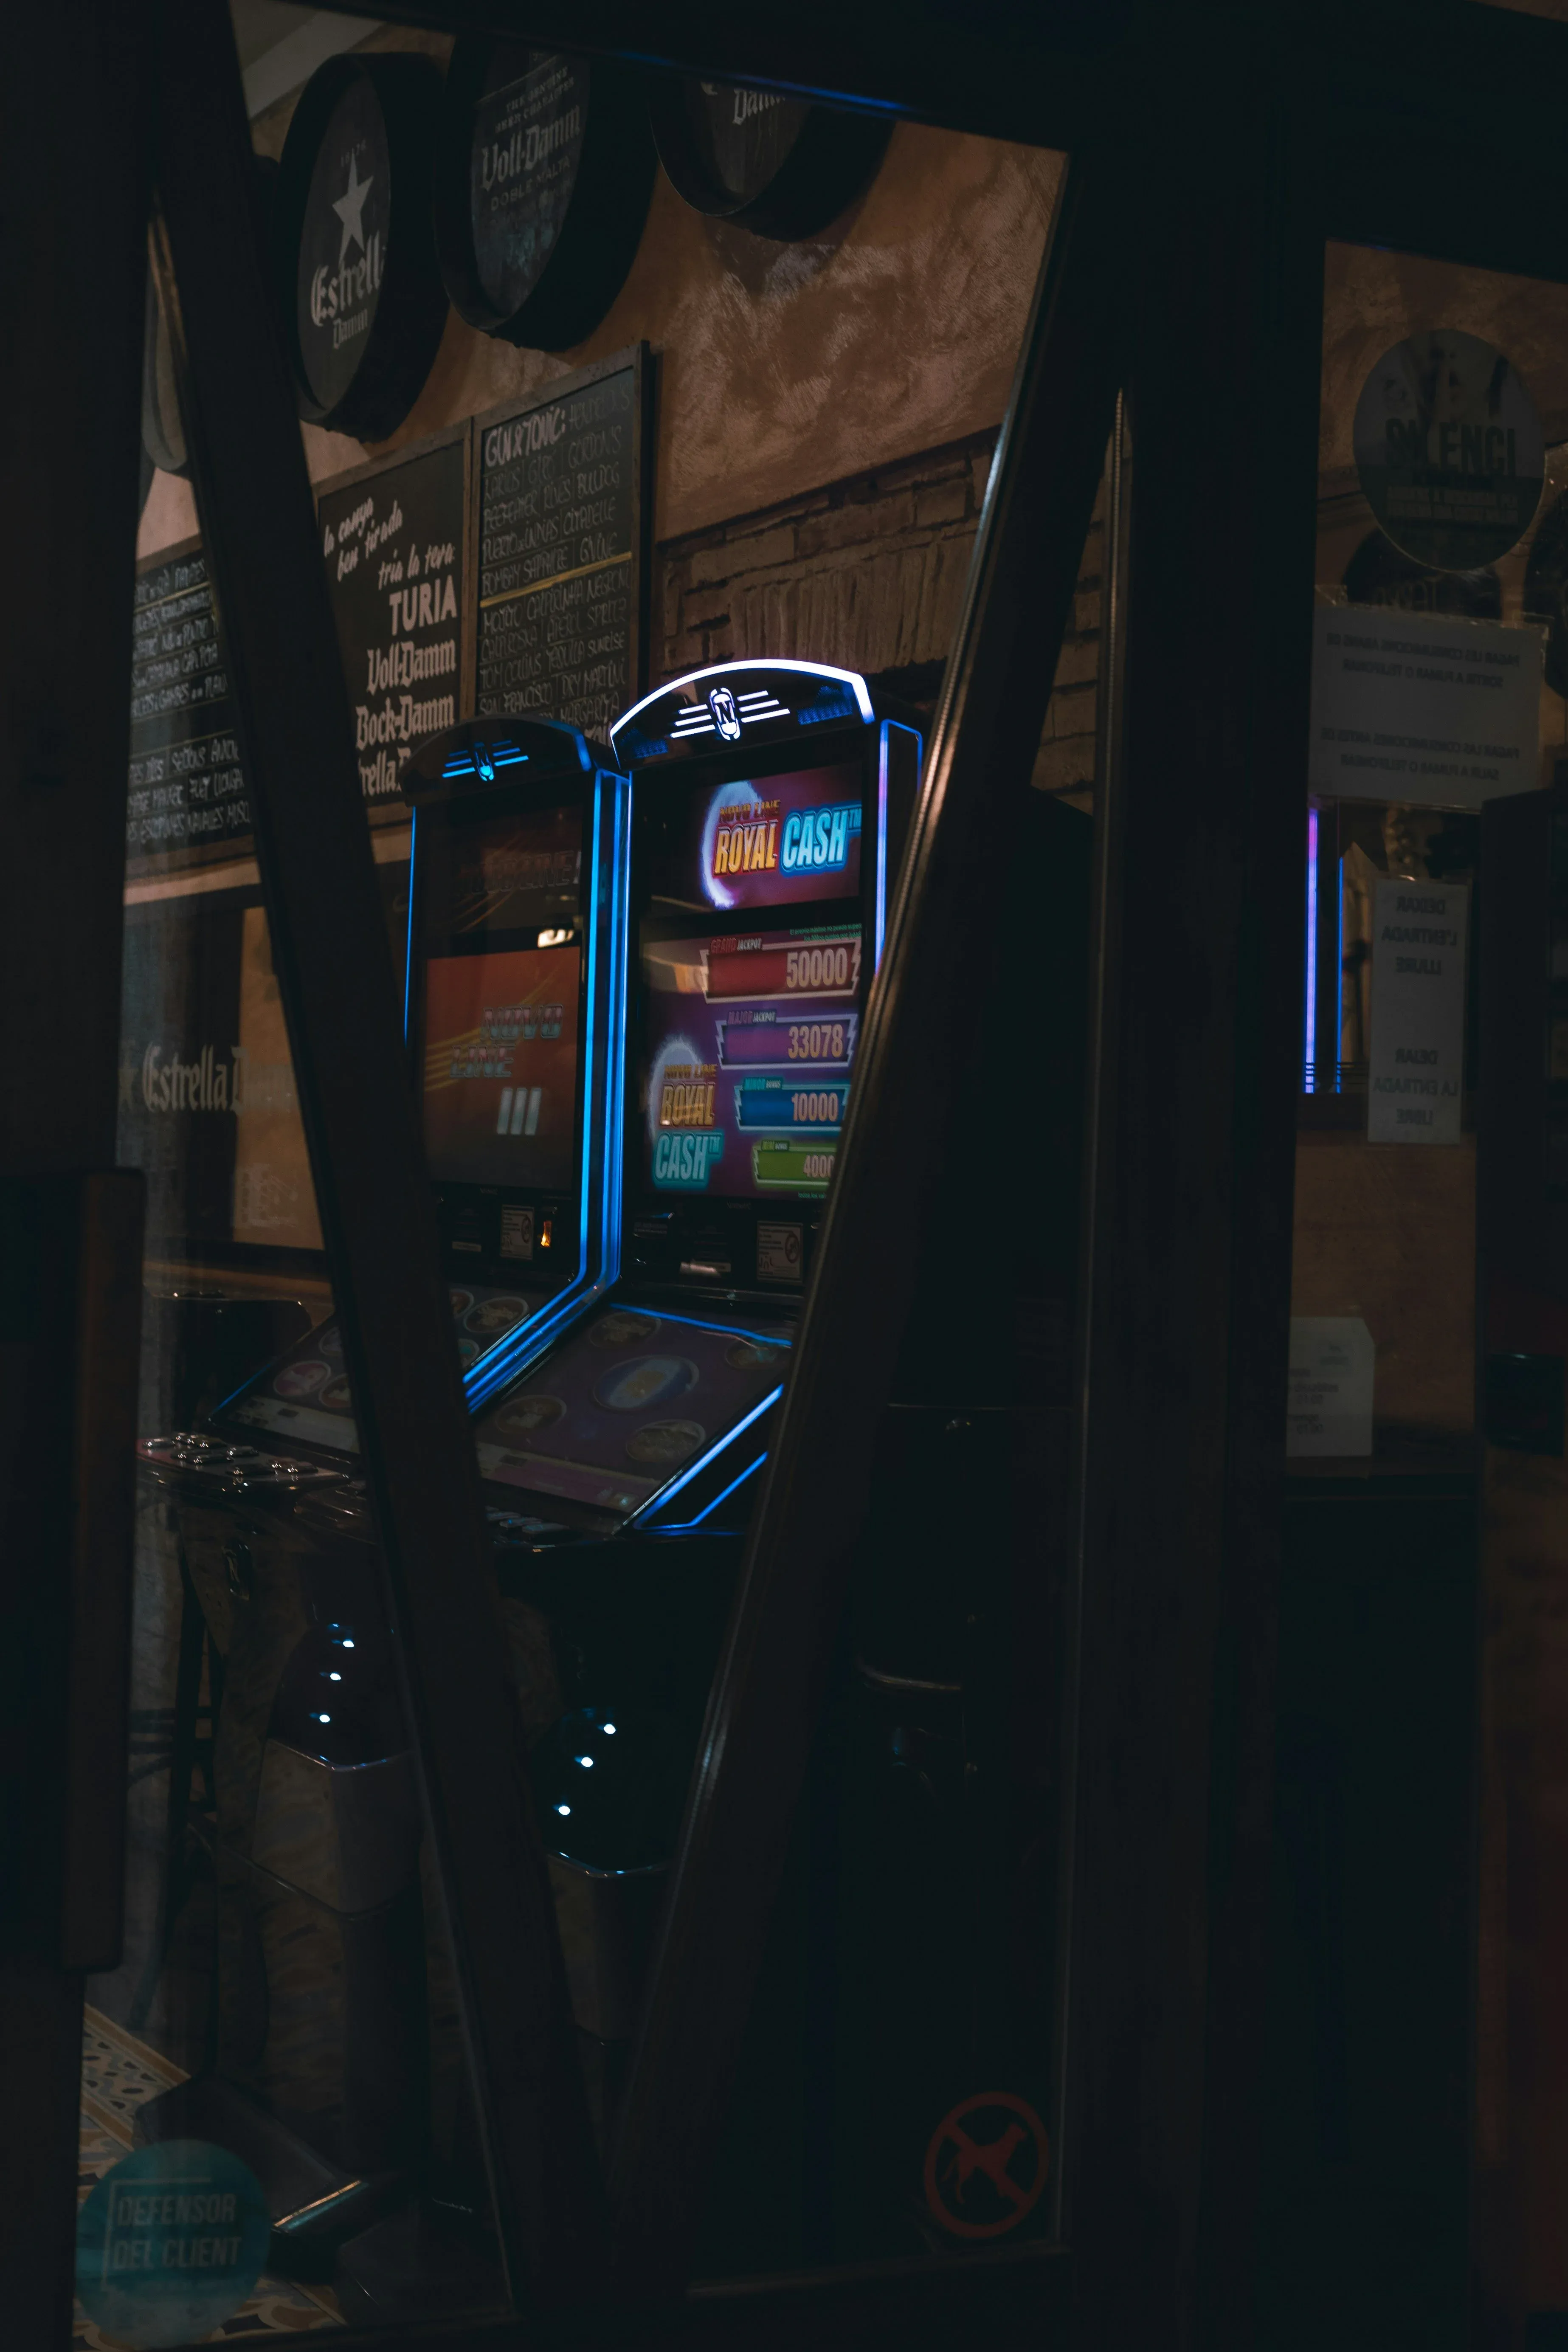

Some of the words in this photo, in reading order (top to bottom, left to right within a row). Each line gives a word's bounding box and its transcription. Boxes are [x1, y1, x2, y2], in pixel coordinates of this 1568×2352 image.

[732, 87, 785, 126] Dam
[480, 104, 580, 192] Voll-Damm
[310, 229, 387, 328] Estrell
[389, 574, 458, 637] TURIA
[366, 639, 457, 696] Voll-Damm
[355, 693, 455, 752] Bock-Damm
[714, 819, 779, 875] ROYAL
[737, 938, 762, 951] JACKPOT
[786, 947, 848, 989] 50000
[479, 1003, 563, 1040] NOVO
[753, 1011, 776, 1023] JACKPOT
[449, 1044, 517, 1078] LINE
[788, 1023, 844, 1060] 33078
[141, 1040, 228, 1113] Estrella
[659, 1082, 716, 1129] ROYAL
[791, 1092, 839, 1122] 10000
[117, 2193, 236, 2226] DEFENSOR
[112, 2239, 154, 2270] DEL
[161, 2236, 242, 2268] CLIENT
